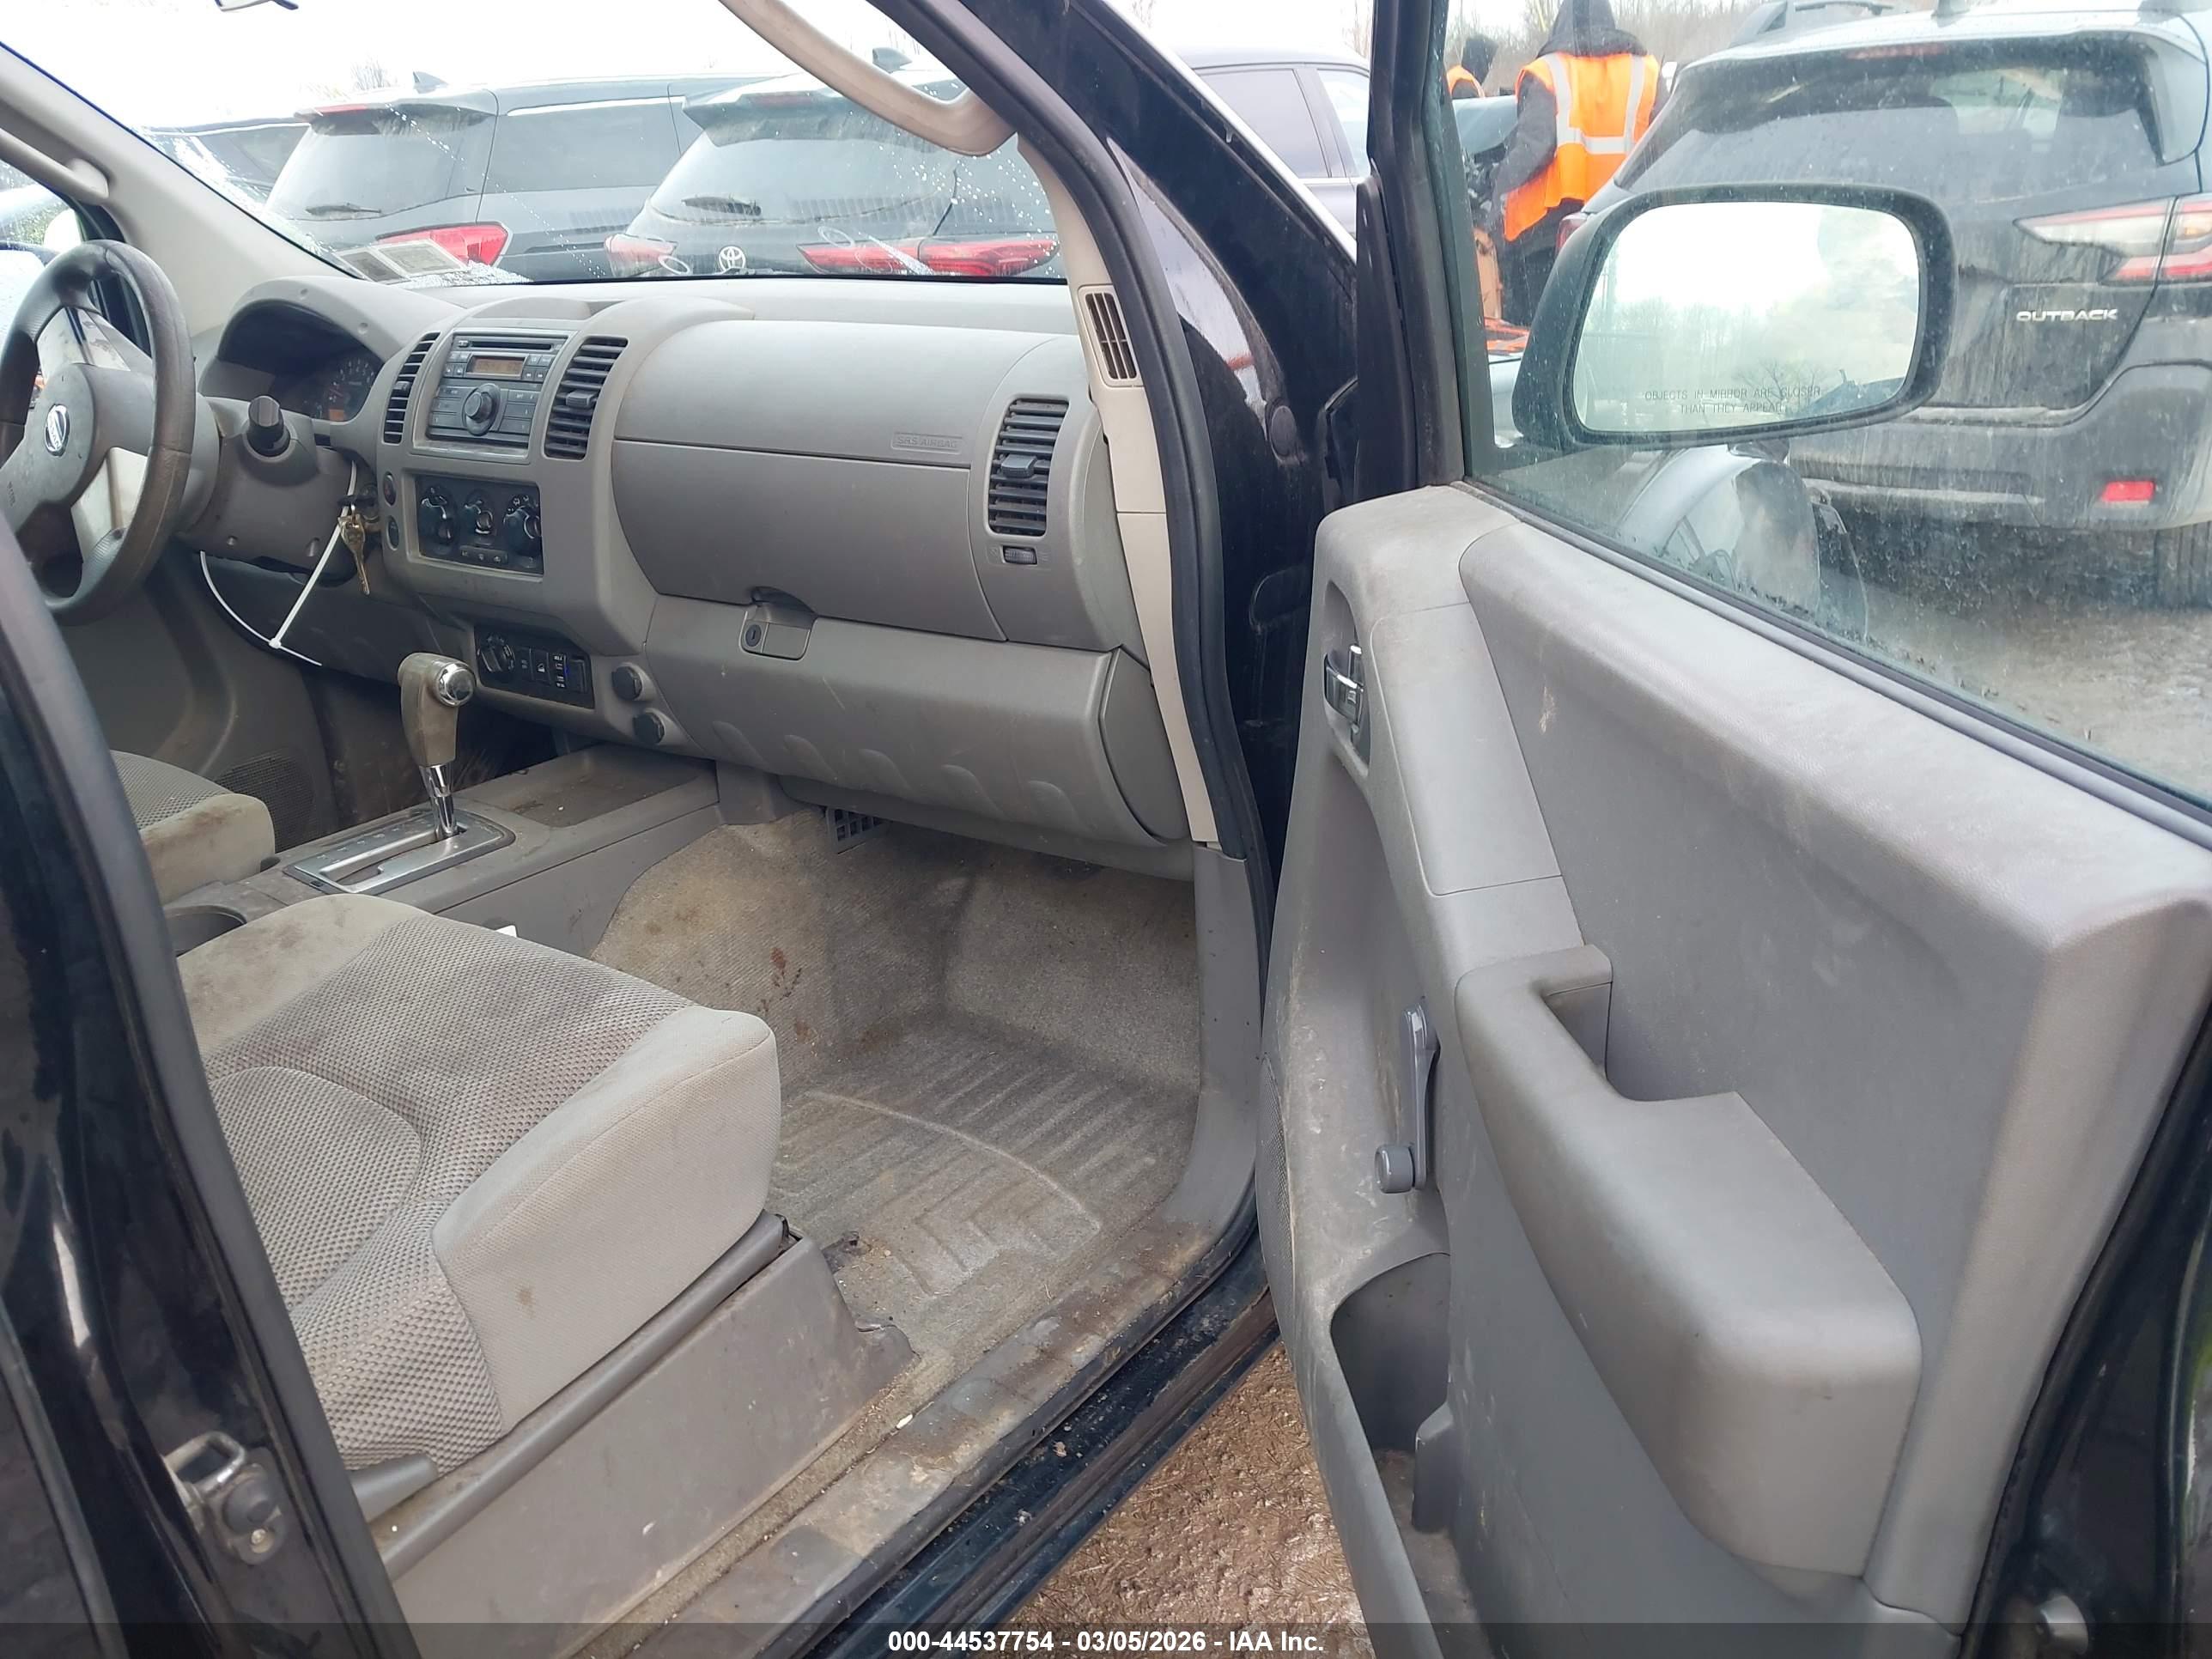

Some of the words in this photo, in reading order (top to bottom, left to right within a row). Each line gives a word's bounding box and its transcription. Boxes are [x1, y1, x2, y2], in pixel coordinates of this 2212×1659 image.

[2016, 309, 2118, 322] OUTBACK
[1644, 390, 1688, 401] OBJECTS
[1694, 390, 1704, 399] IN
[1710, 388, 1747, 399] MIRROR
[1753, 387, 1772, 398] ARE
[1781, 386, 1821, 398] CLOSER
[1680, 404, 1706, 415] THAN
[1712, 403, 1736, 413] THEY
[1743, 401, 1785, 413] APPEAR
[897, 436, 918, 445] SRS
[920, 439, 959, 447] AIRBAG
